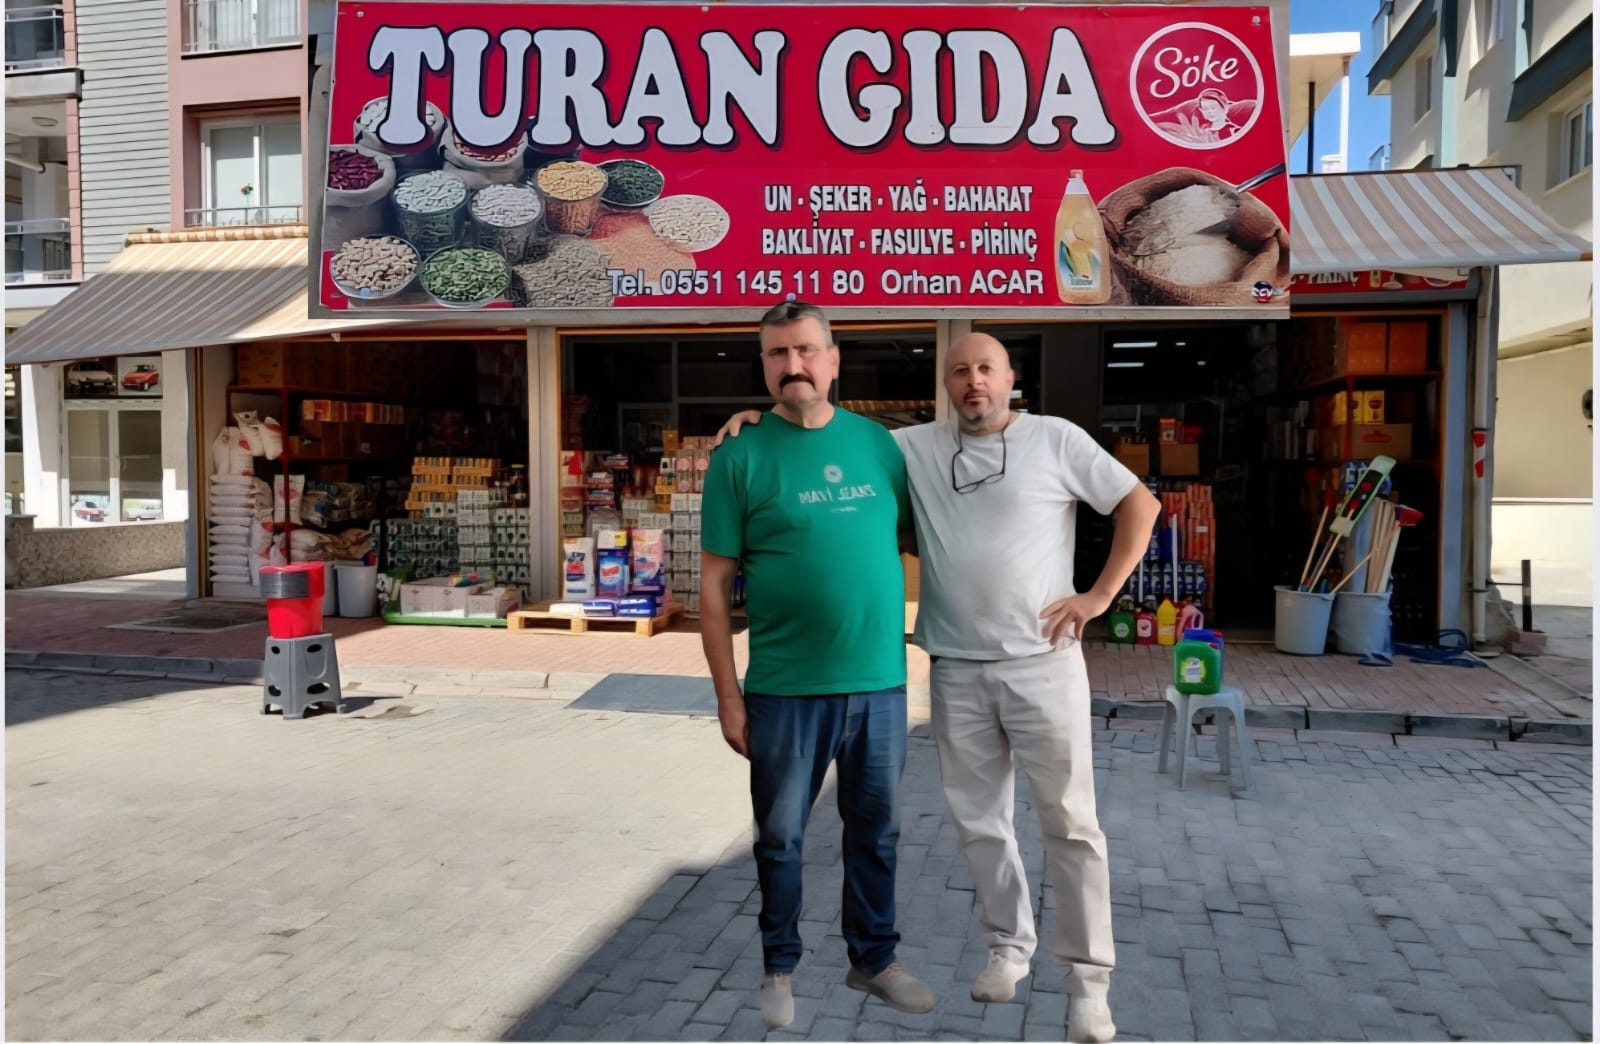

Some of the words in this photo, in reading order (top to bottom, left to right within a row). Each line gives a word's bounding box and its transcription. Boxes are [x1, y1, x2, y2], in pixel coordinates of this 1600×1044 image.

[368, 25, 787, 148] TURAN
[817, 26, 1118, 148] GIDA
[1149, 44, 1240, 98] Söke
[764, 184, 792, 212] UN
[809, 184, 872, 219] ŞEKER
[888, 178, 927, 212] YAĞ
[944, 185, 1033, 212] BAHARAT
[762, 221, 854, 255] BAKLİYAT
[871, 228, 955, 255] FASULYE
[970, 221, 1038, 262] PİRİNÇ
[607, 269, 651, 295] Tel.
[661, 269, 722, 295] 0551
[736, 270, 783, 295] 145
[793, 269, 820, 295] 11
[832, 269, 865, 295] 80
[881, 268, 962, 295] Orhan
[969, 268, 1044, 295] ACAR
